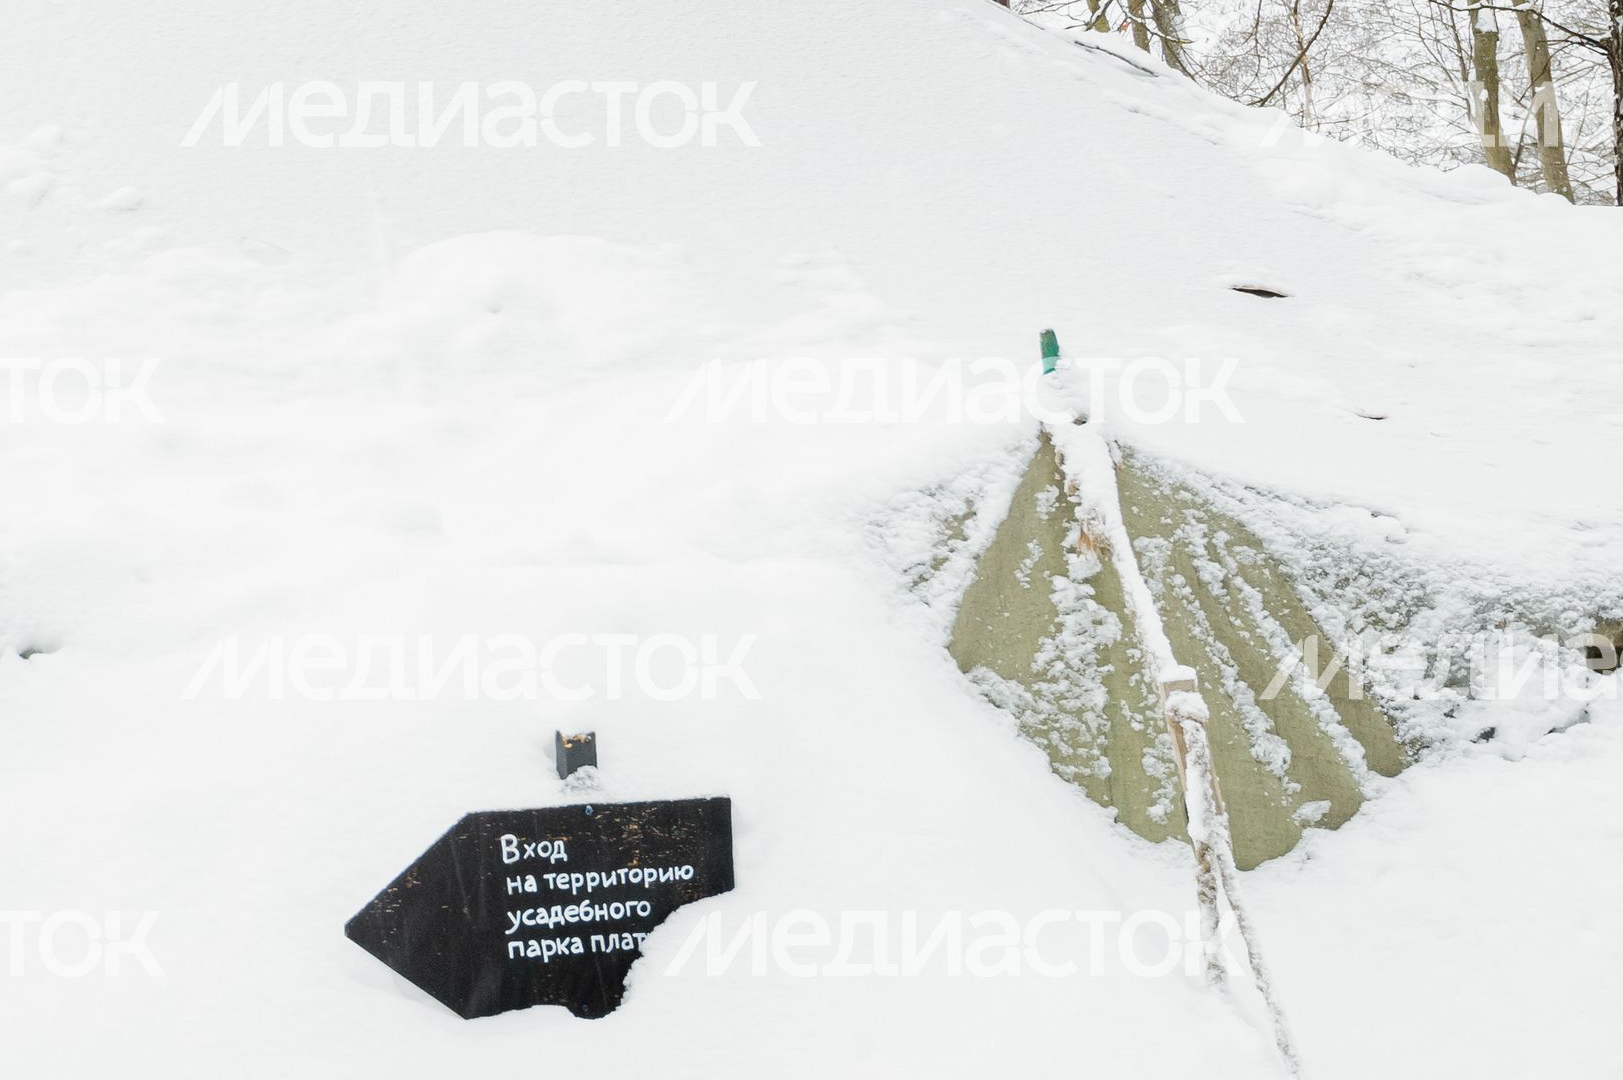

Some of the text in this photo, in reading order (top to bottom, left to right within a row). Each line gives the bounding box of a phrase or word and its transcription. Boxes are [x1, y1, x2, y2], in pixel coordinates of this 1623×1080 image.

[500, 834, 568, 864] Вход
[506, 865, 694, 895] на территорию
[505, 899, 651, 934] усадебного
[508, 931, 649, 963] парка плат
